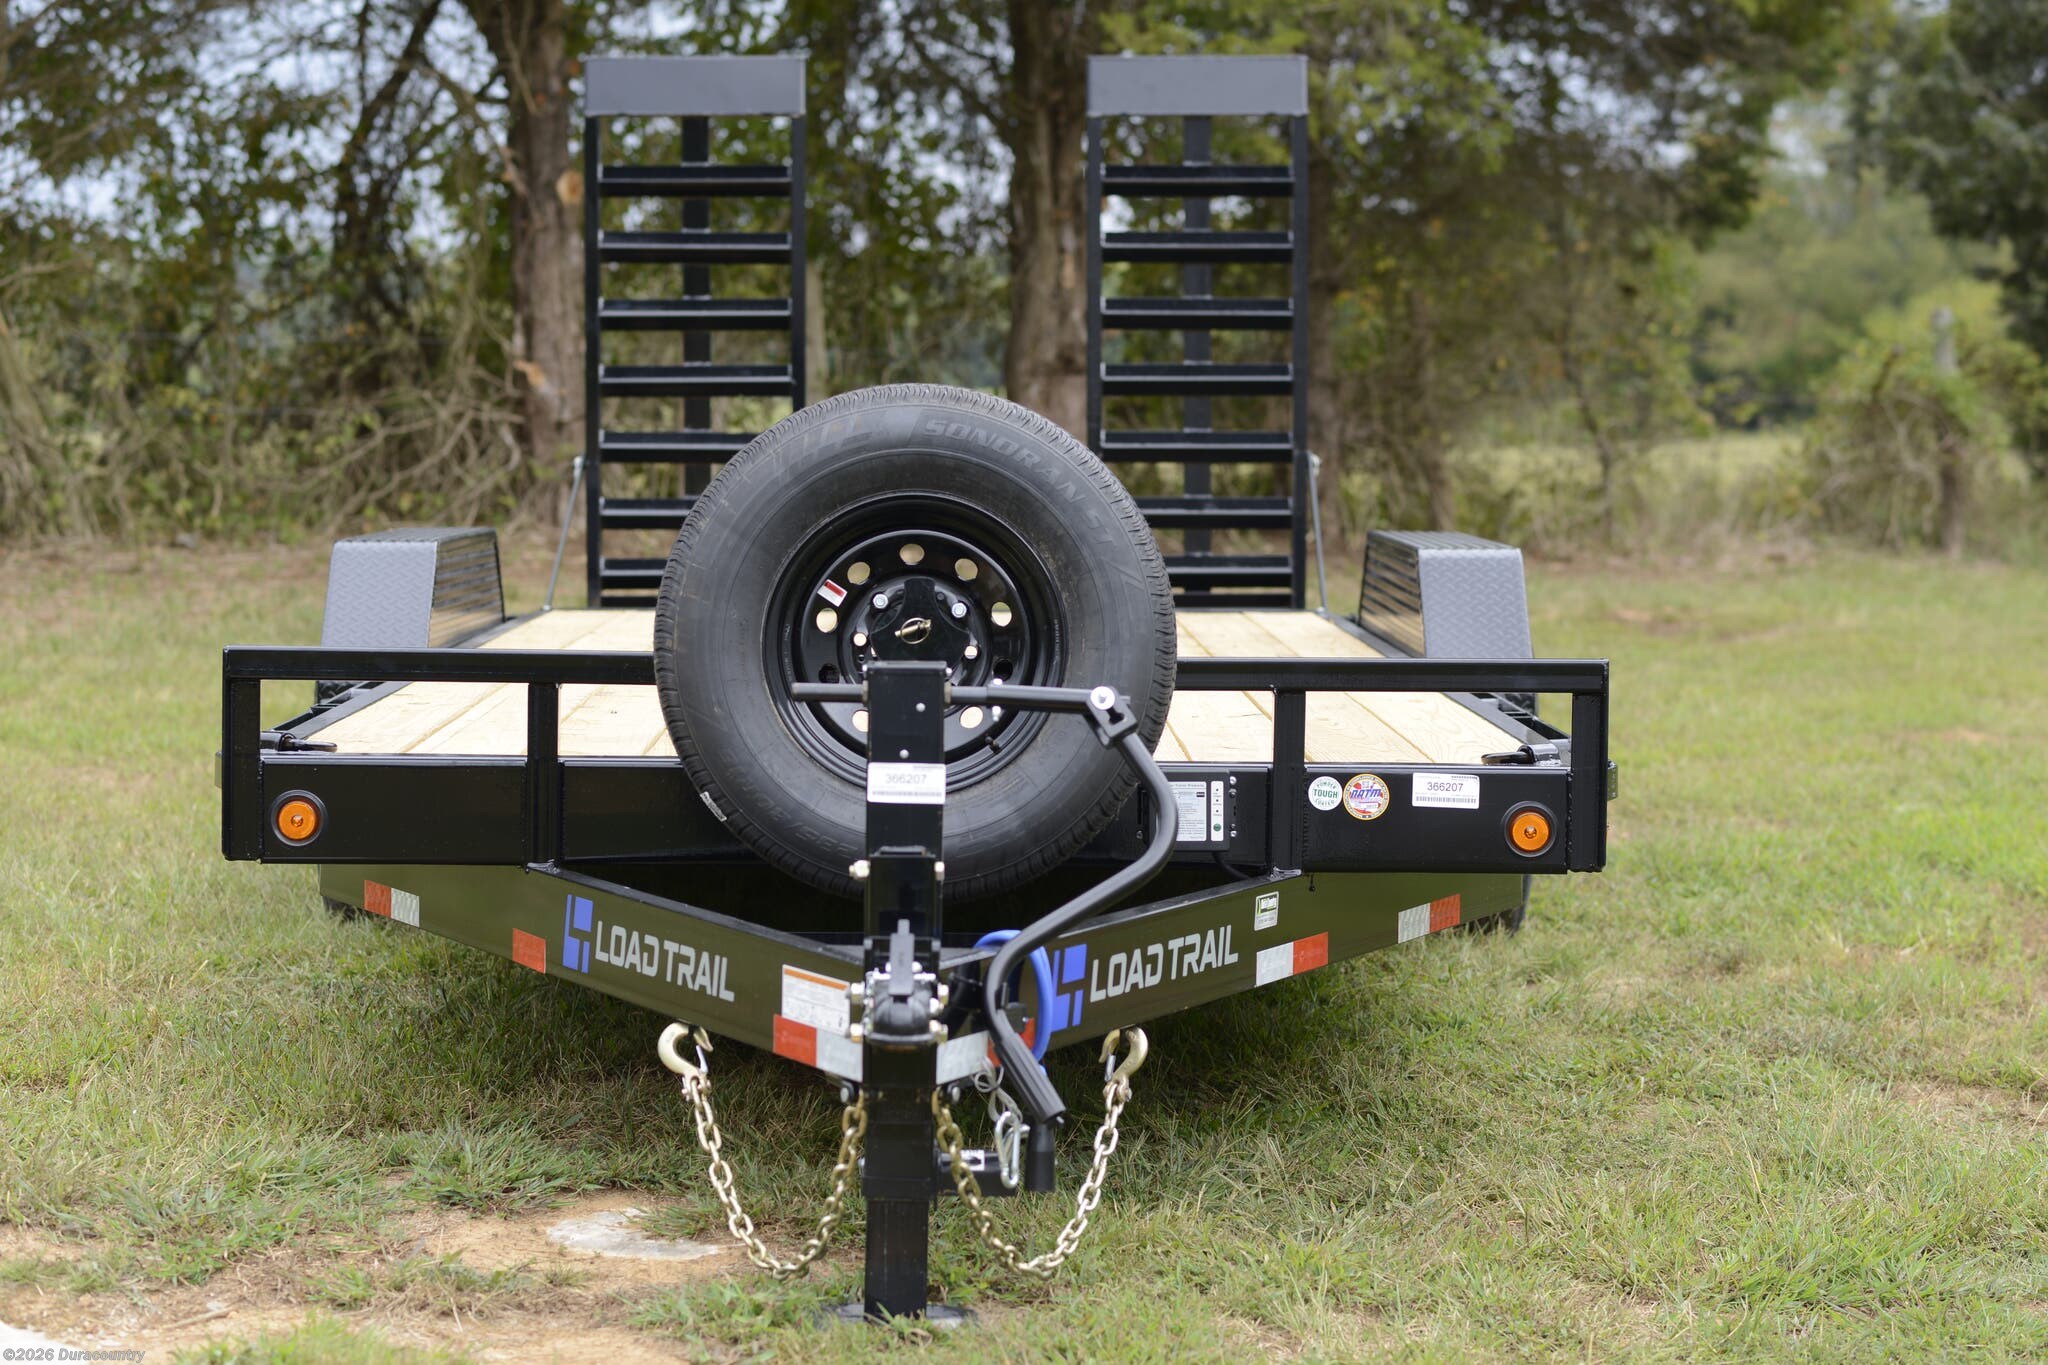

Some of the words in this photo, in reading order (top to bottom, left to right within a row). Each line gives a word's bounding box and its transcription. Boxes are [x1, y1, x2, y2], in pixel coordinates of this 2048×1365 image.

[924, 418, 1088, 504] SONORAN
[1427, 781, 1464, 793] 366207
[1313, 788, 1339, 799] TOUGH
